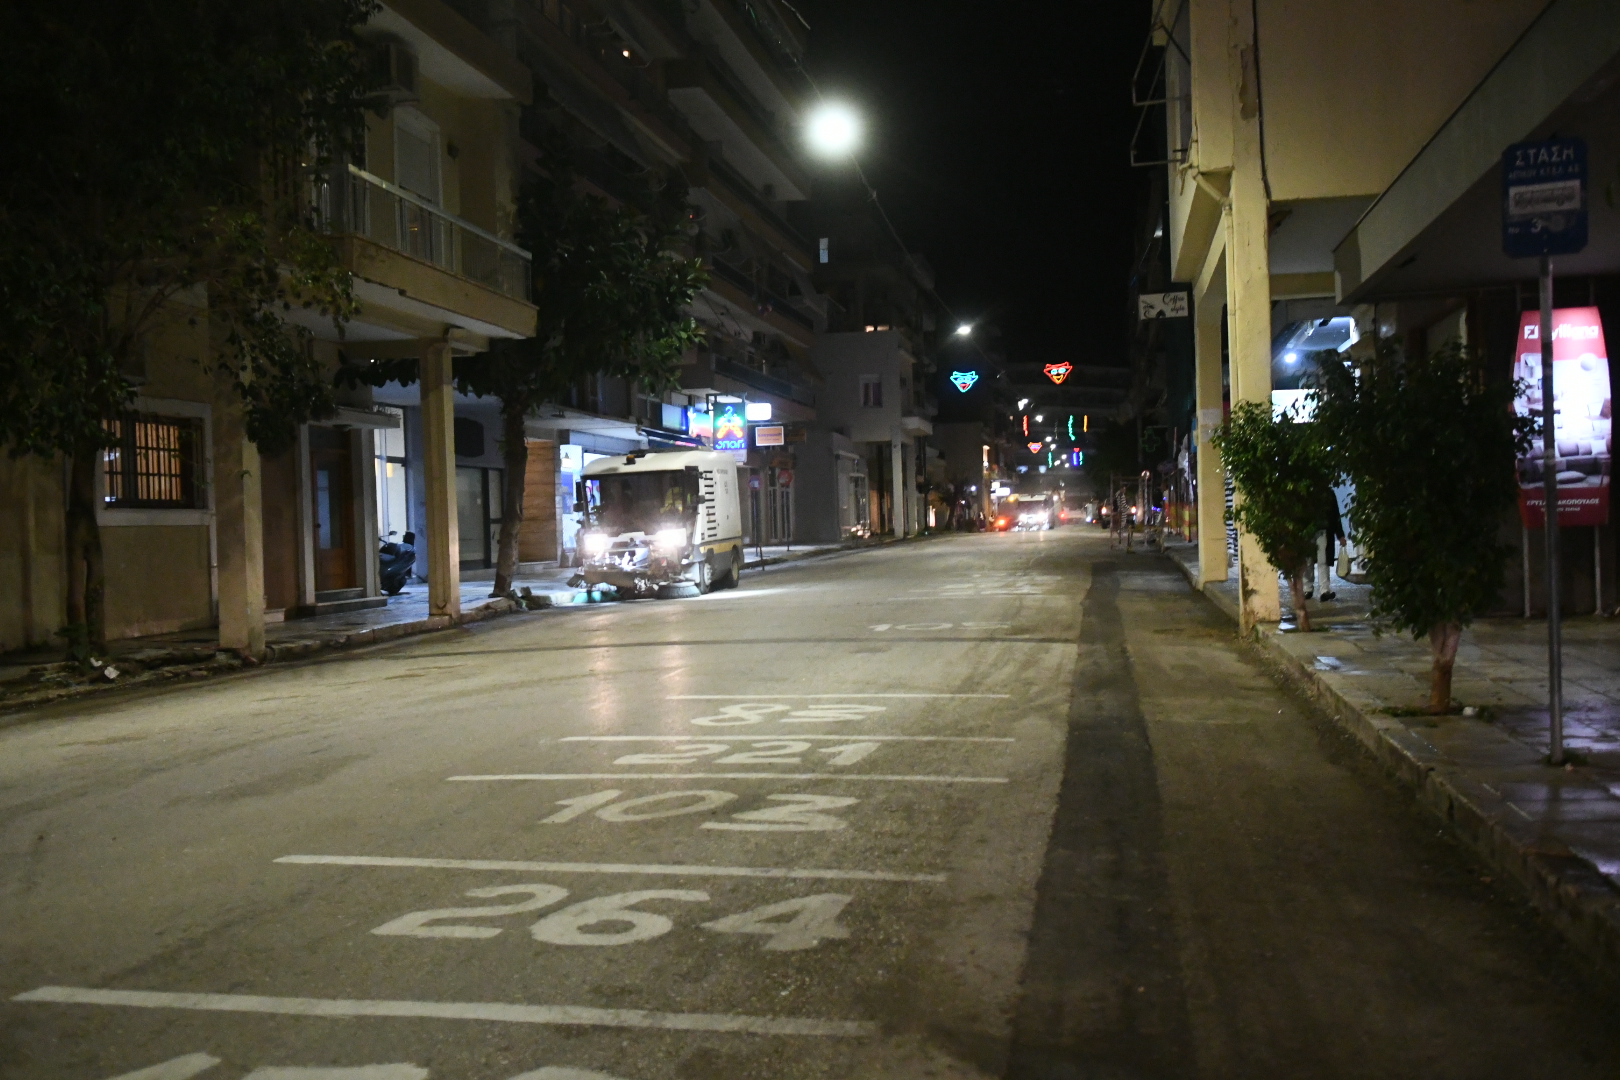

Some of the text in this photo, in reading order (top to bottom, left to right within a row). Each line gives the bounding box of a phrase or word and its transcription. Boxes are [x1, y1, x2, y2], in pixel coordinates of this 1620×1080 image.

[1515, 145, 1574, 166] ΣΤΑΣΗ
[1551, 323, 1599, 341] ylliana
[613, 740, 882, 766] 221
[539, 789, 861, 831] 103
[370, 883, 855, 951] 264
